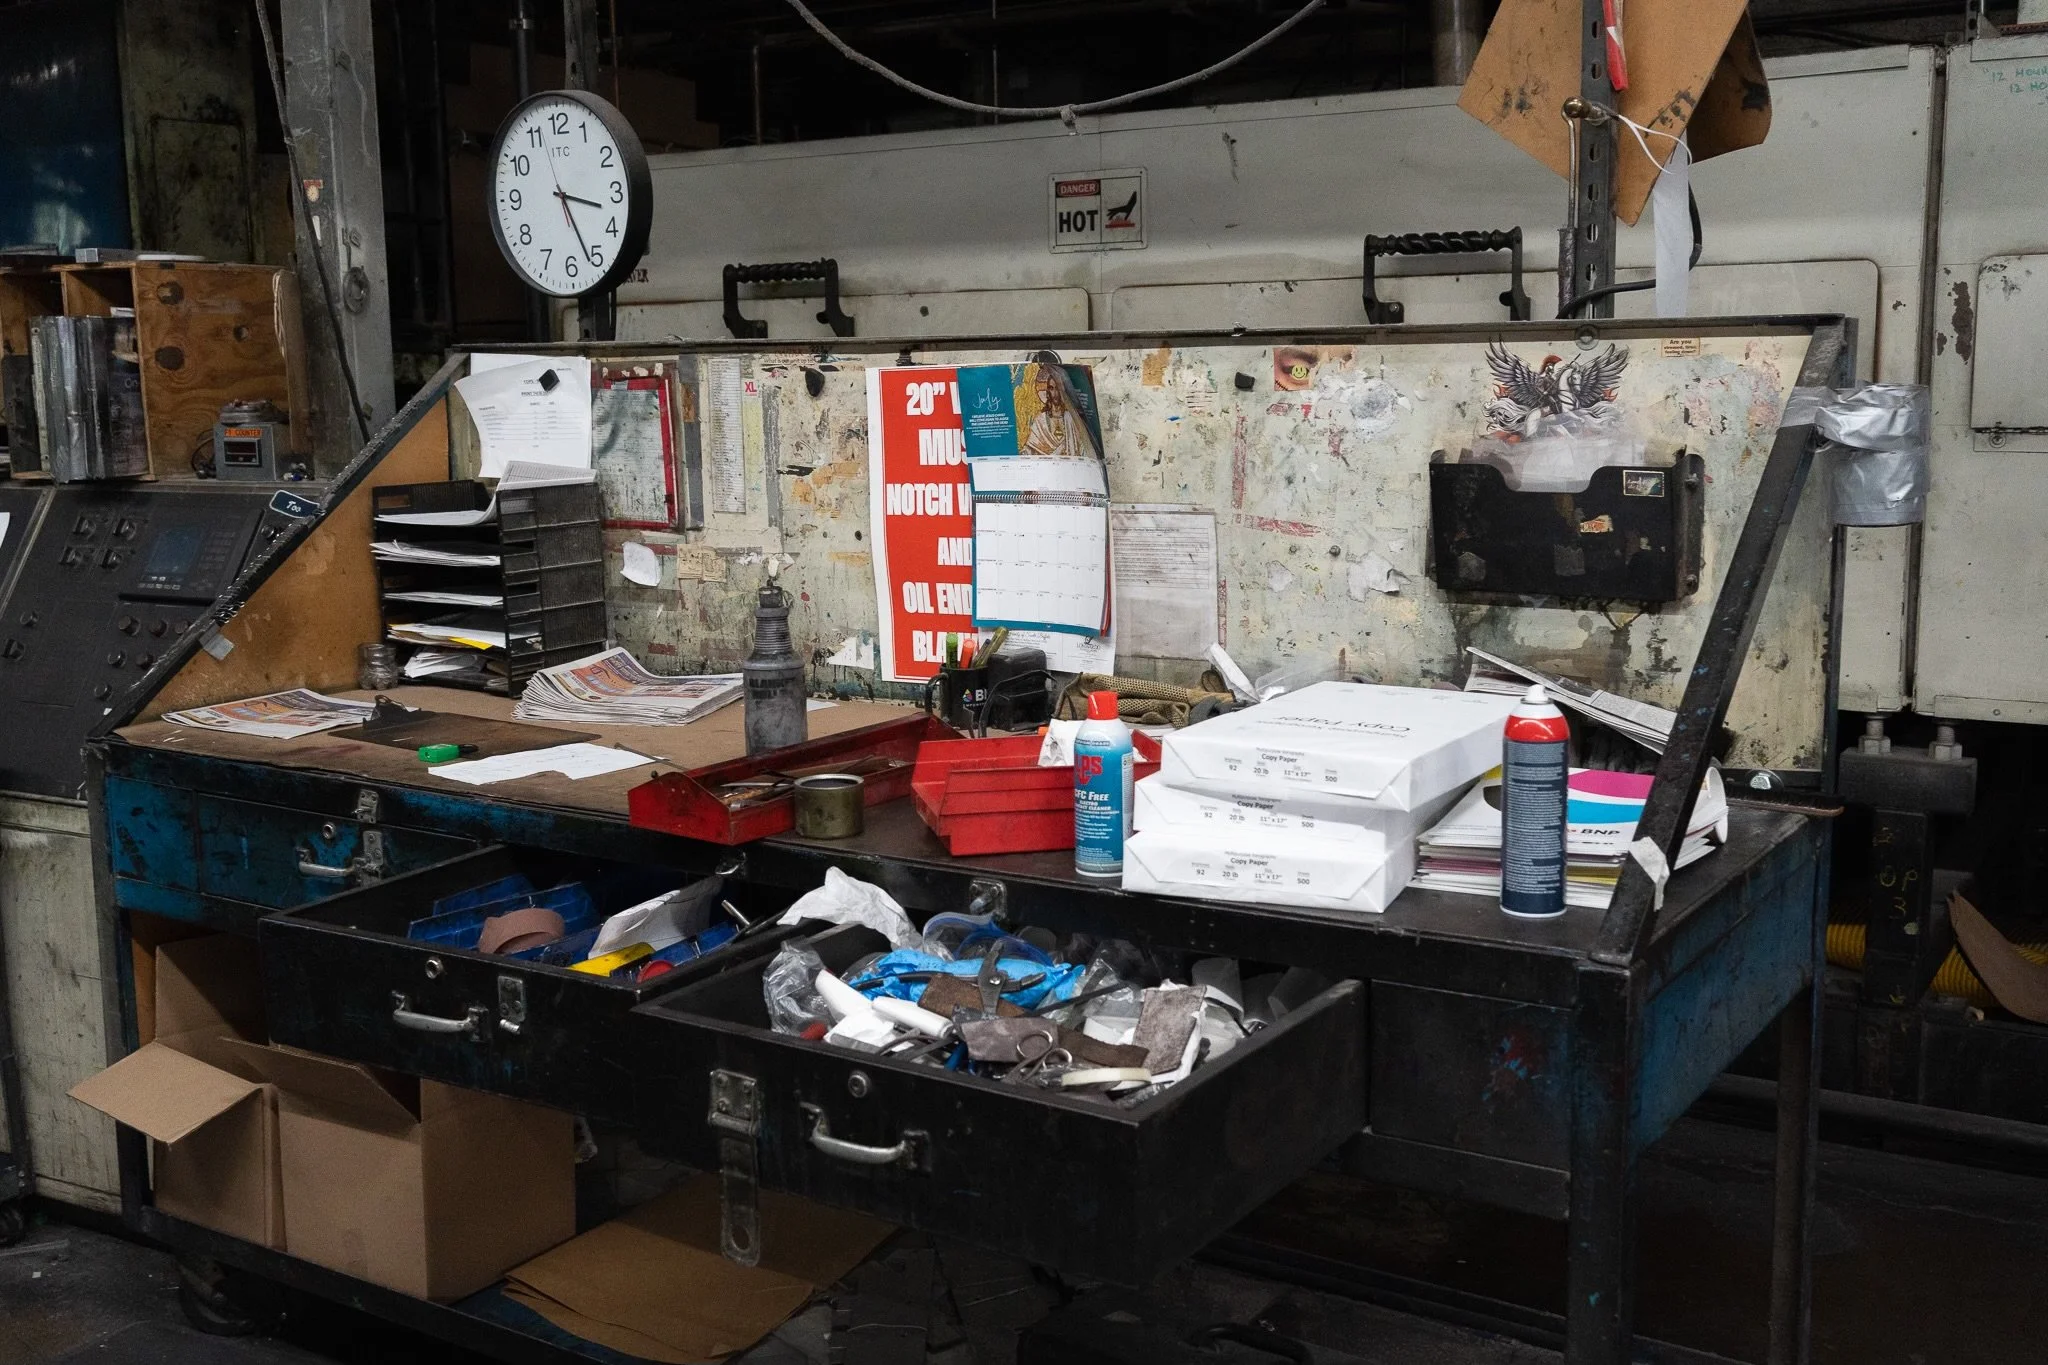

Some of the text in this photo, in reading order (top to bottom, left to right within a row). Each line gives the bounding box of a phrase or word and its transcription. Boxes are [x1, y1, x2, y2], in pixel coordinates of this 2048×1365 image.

[548, 112, 570, 135] 12
[578, 121, 588, 143] 1
[527, 125, 542, 148] 11
[551, 146, 571, 158] ITC
[600, 145, 614, 168] 2
[510, 154, 530, 177] 10
[609, 180, 624, 204] 3
[1060, 183, 1096, 194] DANGER
[509, 189, 522, 211] 9
[605, 215, 619, 238] 4
[1059, 209, 1098, 233] HOT
[519, 223, 532, 245] 8
[539, 248, 553, 270] 7
[565, 255, 579, 278] 6
[590, 245, 604, 267] 5
[744, 381, 758, 393] XL
[973, 387, 1001, 412] July
[886, 482, 953, 516] NOTCH
[937, 536, 973, 566] AND
[902, 581, 973, 616] OIL END
[1261, 753, 1297, 763] Copy Paper
[1325, 775, 1338, 783] 500
[1088, 791, 1110, 801] FREE
[1237, 800, 1274, 810] Copy Paper
[1580, 828, 1621, 836] BNP
[1230, 857, 1269, 867] Copy Paper
[1297, 877, 1310, 885] 500
